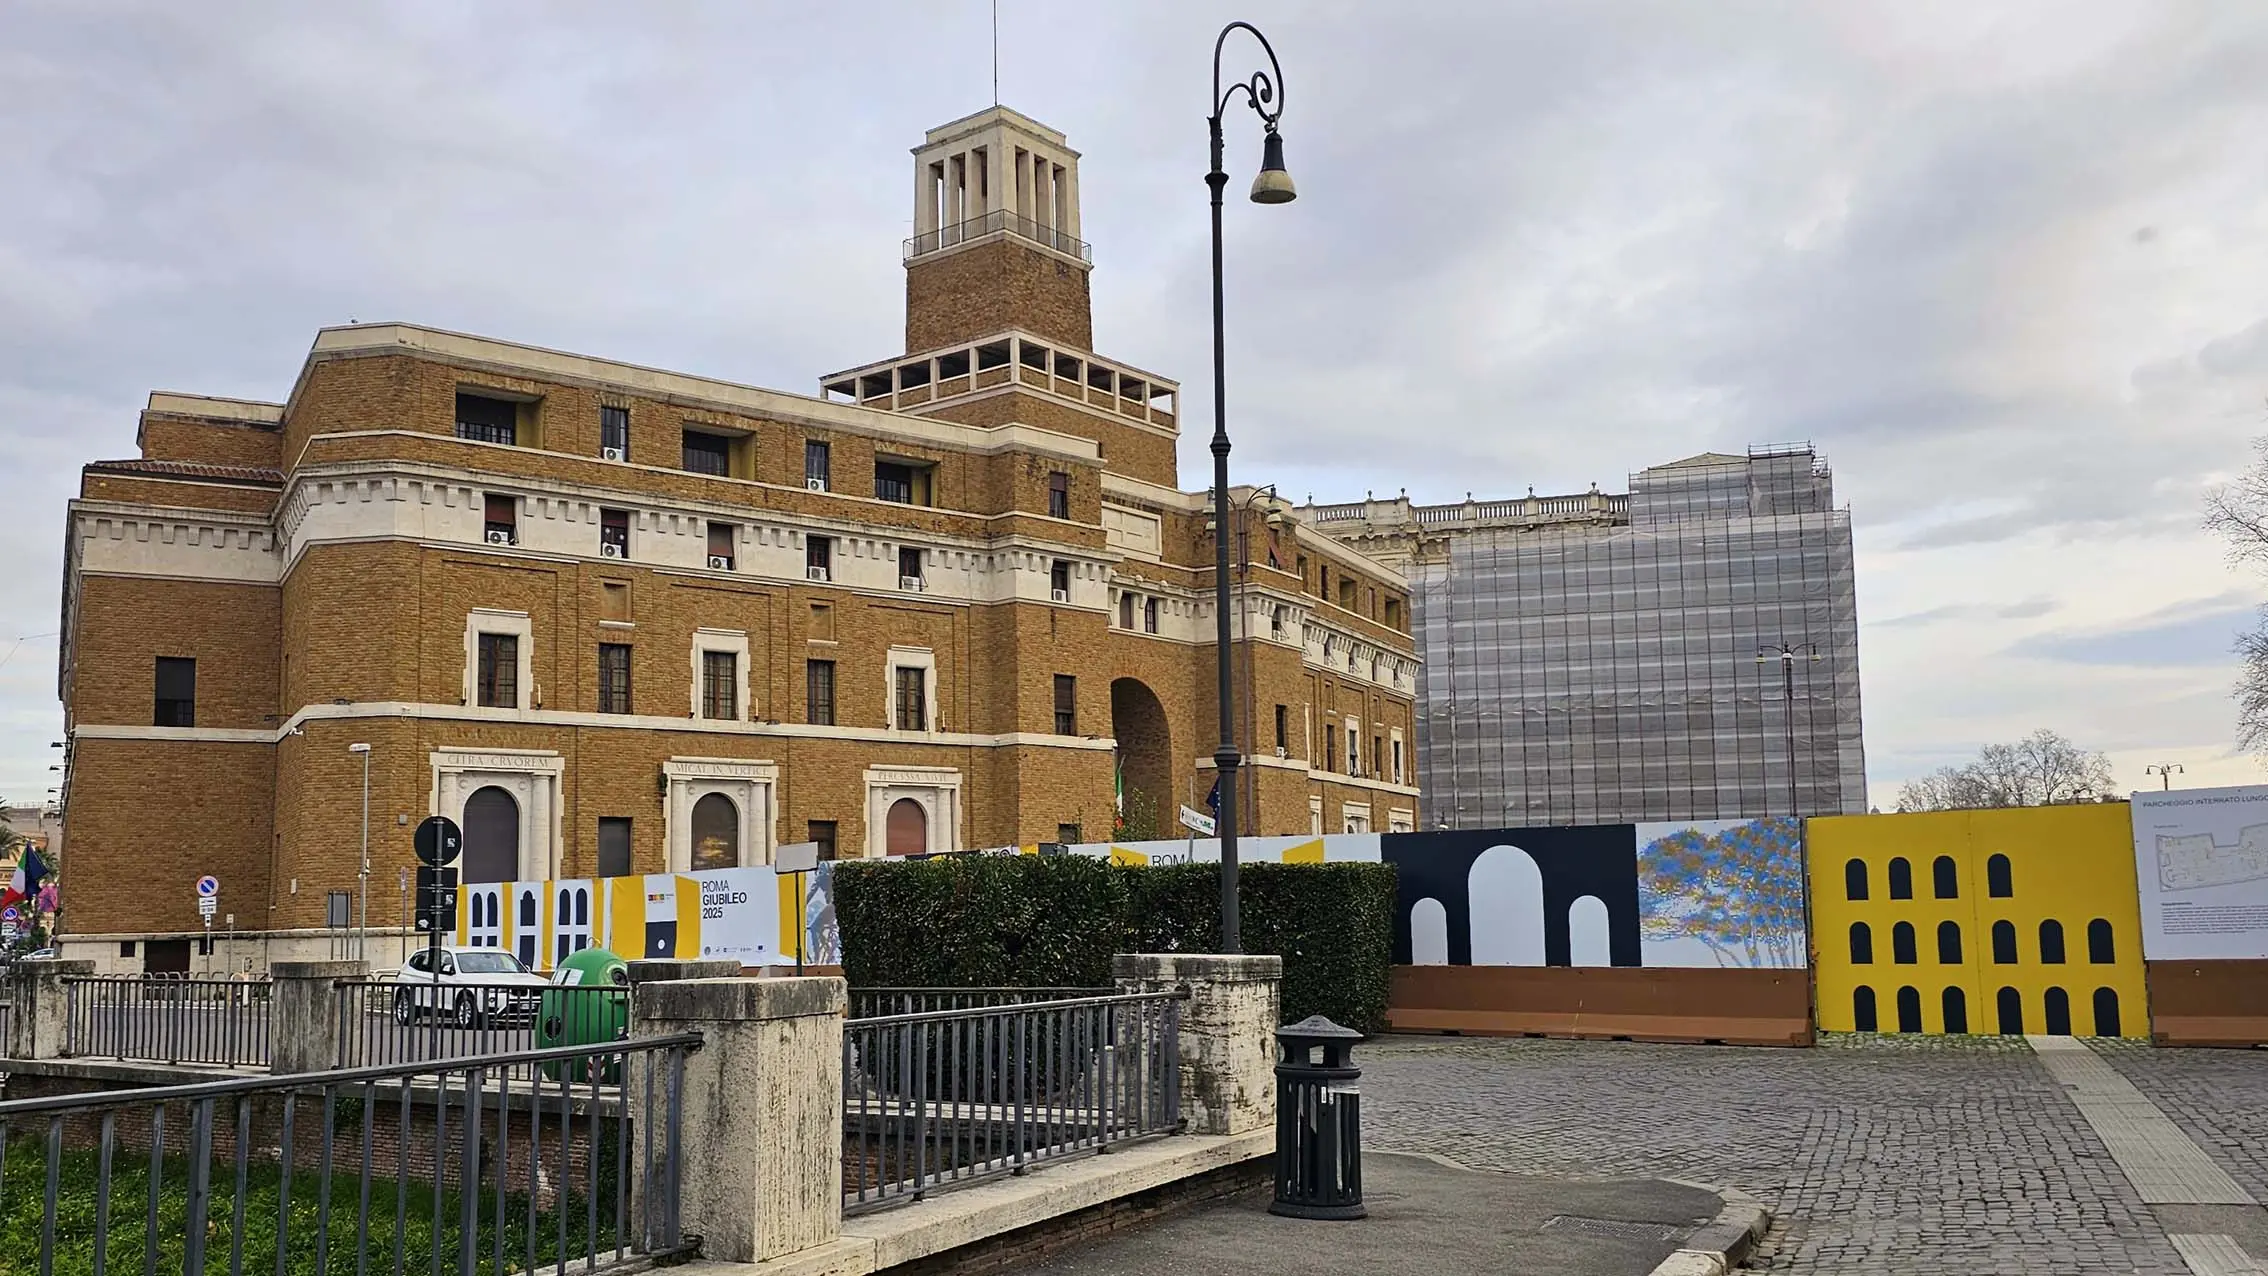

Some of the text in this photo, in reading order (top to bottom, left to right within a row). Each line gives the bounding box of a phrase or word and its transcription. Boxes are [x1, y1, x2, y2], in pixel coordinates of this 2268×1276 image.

[2142, 799, 2194, 808] PARCHEGGIO
[2195, 795, 2240, 805] INTERRATO
[1151, 853, 1196, 867] ROM
[702, 880, 730, 893] ROMA
[702, 892, 748, 906] GIUBILEO
[702, 906, 723, 919] 2025
